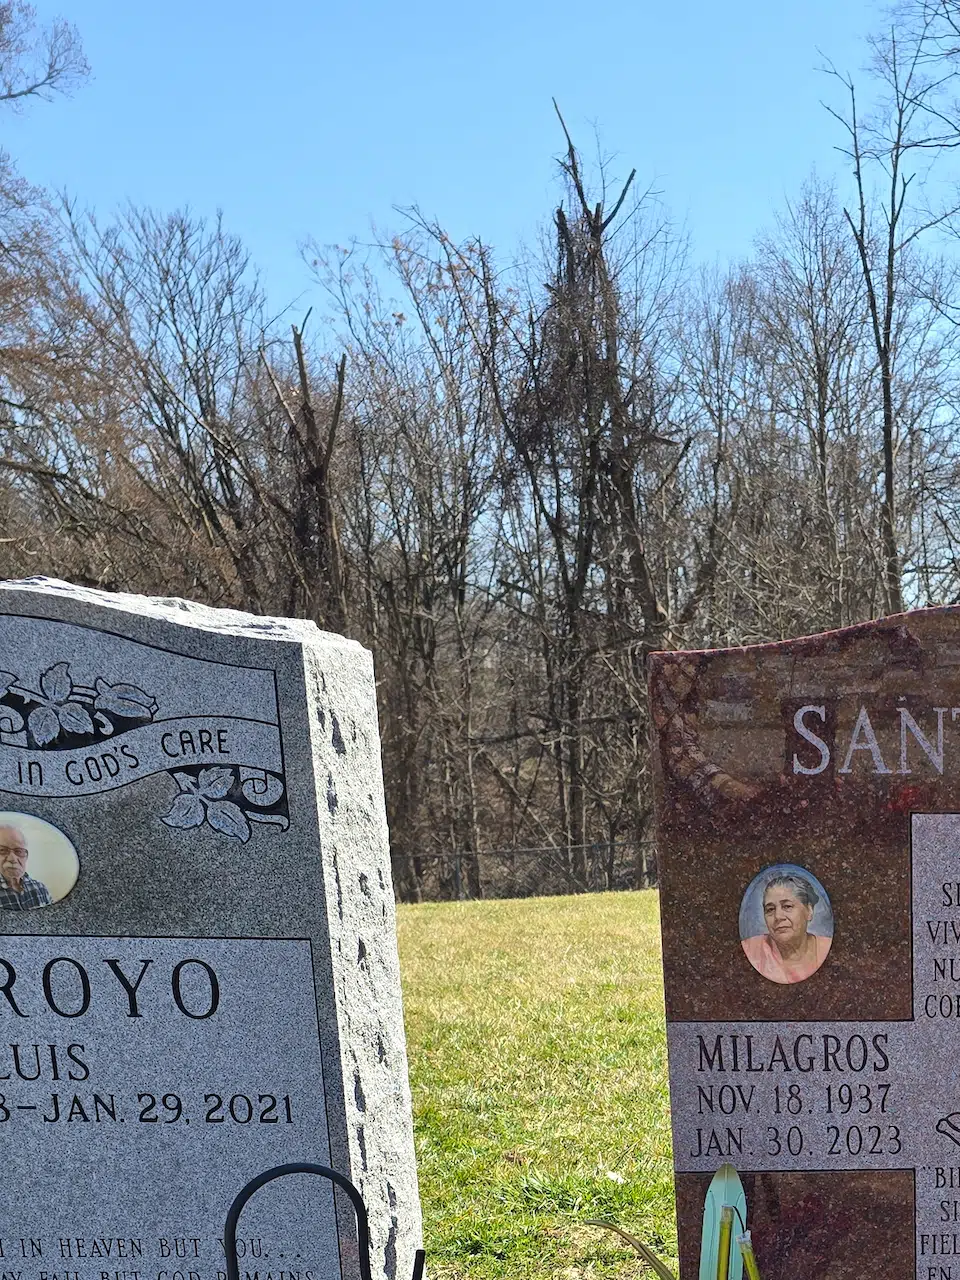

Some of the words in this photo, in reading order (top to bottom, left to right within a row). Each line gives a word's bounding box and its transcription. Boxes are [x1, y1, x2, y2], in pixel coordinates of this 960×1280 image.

[17, 761, 44, 786] IN
[65, 744, 140, 786] GOD'S
[160, 729, 230, 758] CARE
[696, 1033, 890, 1073] MILAGROS
[204, 1093, 293, 1124] 2021
[697, 1083, 761, 1115] NOV.
[825, 1083, 892, 1114] 1937
[690, 1127, 755, 1158] JAN.
[826, 1125, 903, 1156] 2023
[20, 1238, 43, 1258] IN
[59, 1238, 143, 1258] HEAVEN
[158, 1238, 200, 1258] BUT
